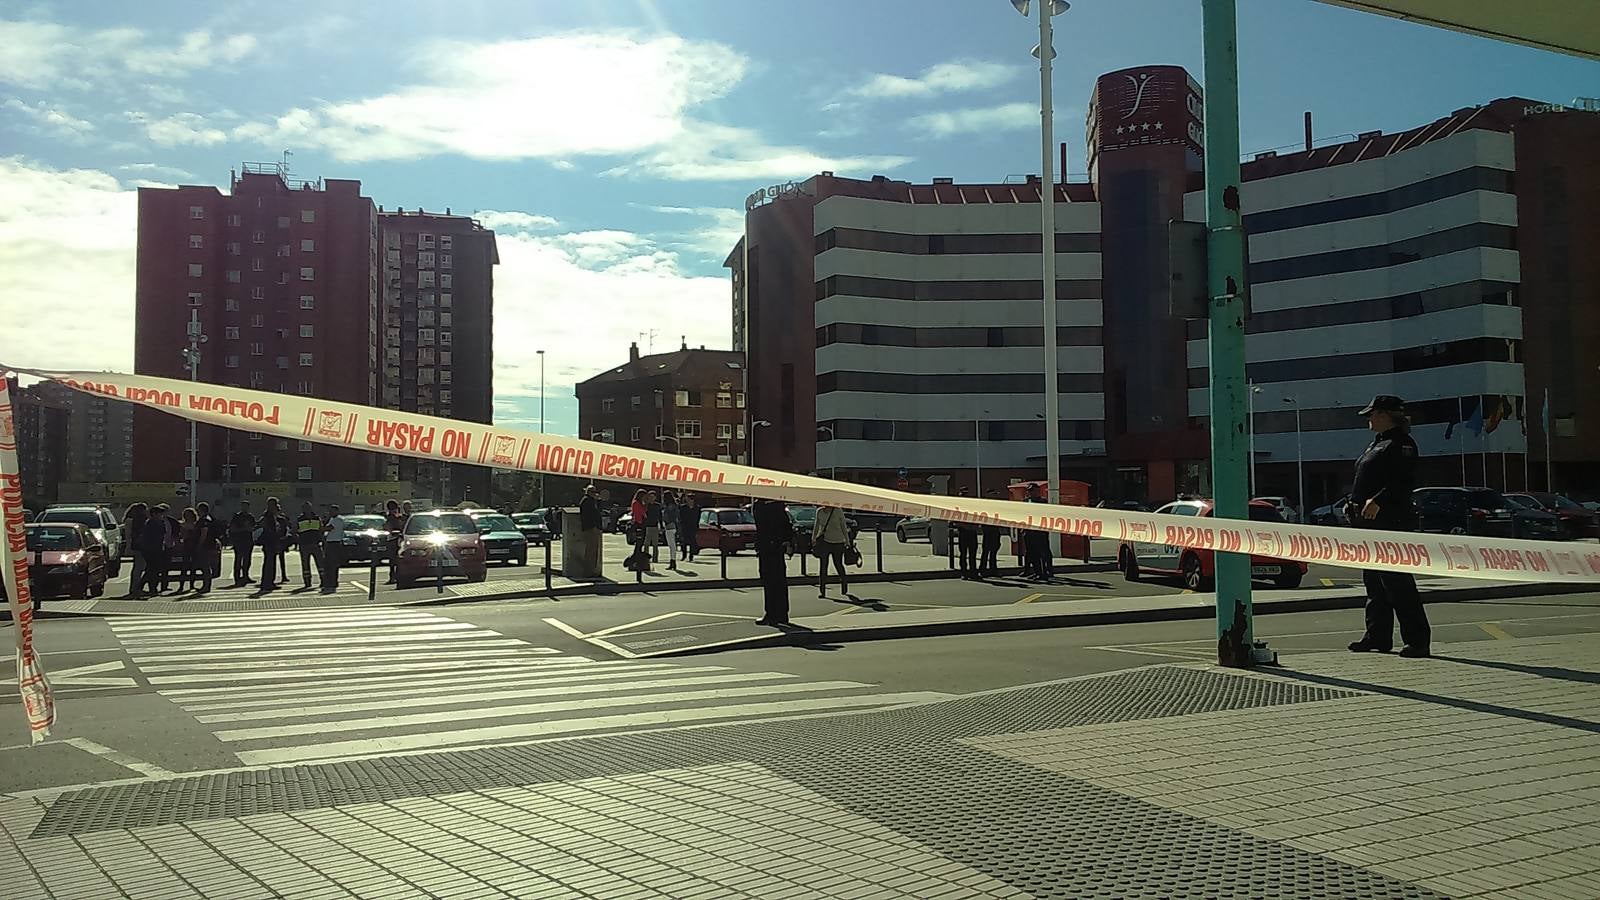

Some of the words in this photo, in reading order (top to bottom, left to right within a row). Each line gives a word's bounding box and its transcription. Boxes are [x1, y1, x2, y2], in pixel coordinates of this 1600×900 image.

[1523, 103, 1569, 116] HOTEL
[366, 418, 436, 454] PASAR
[441, 428, 472, 460] NO
